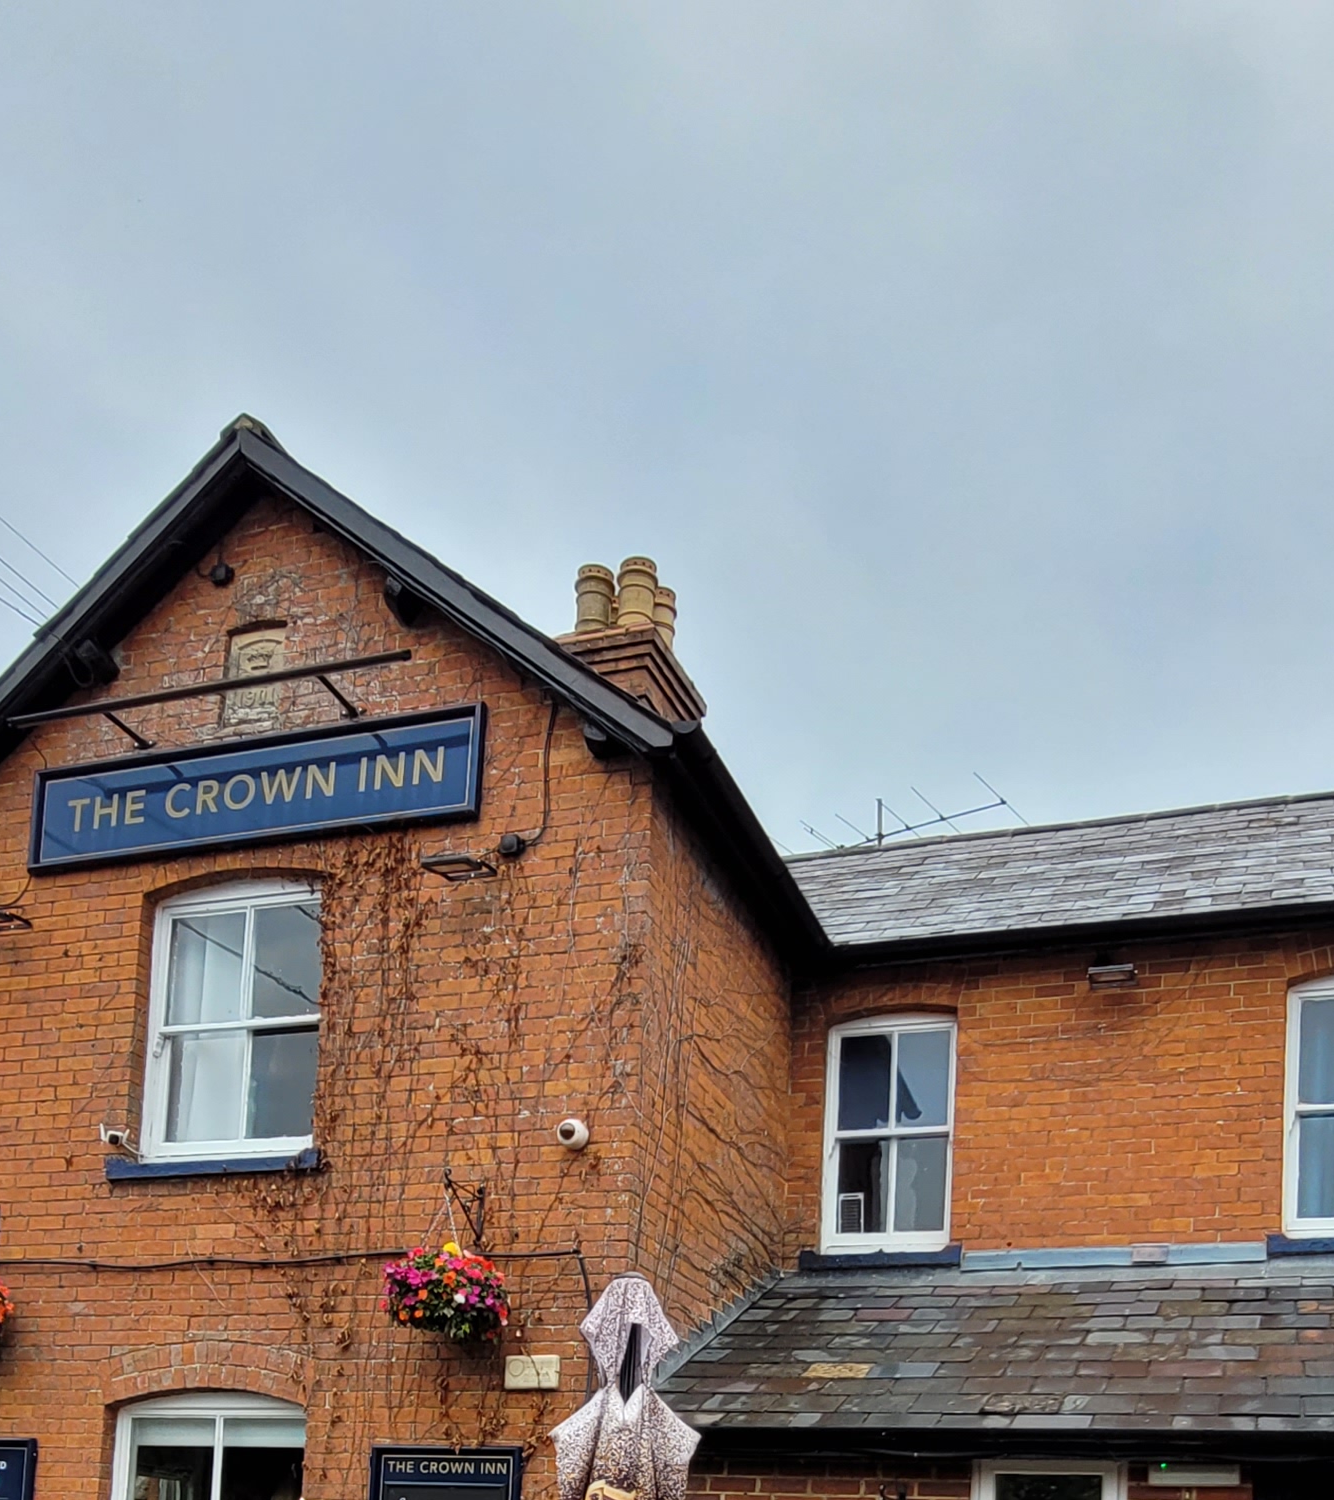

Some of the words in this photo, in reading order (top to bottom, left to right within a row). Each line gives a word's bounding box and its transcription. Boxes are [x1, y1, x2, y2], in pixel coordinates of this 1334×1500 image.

[68, 789, 147, 833] THE
[165, 761, 337, 819] CROWN
[358, 746, 445, 793] INN
[387, 1460, 415, 1474] THE
[419, 1461, 475, 1475] CROWN
[480, 1461, 508, 1476] INN
